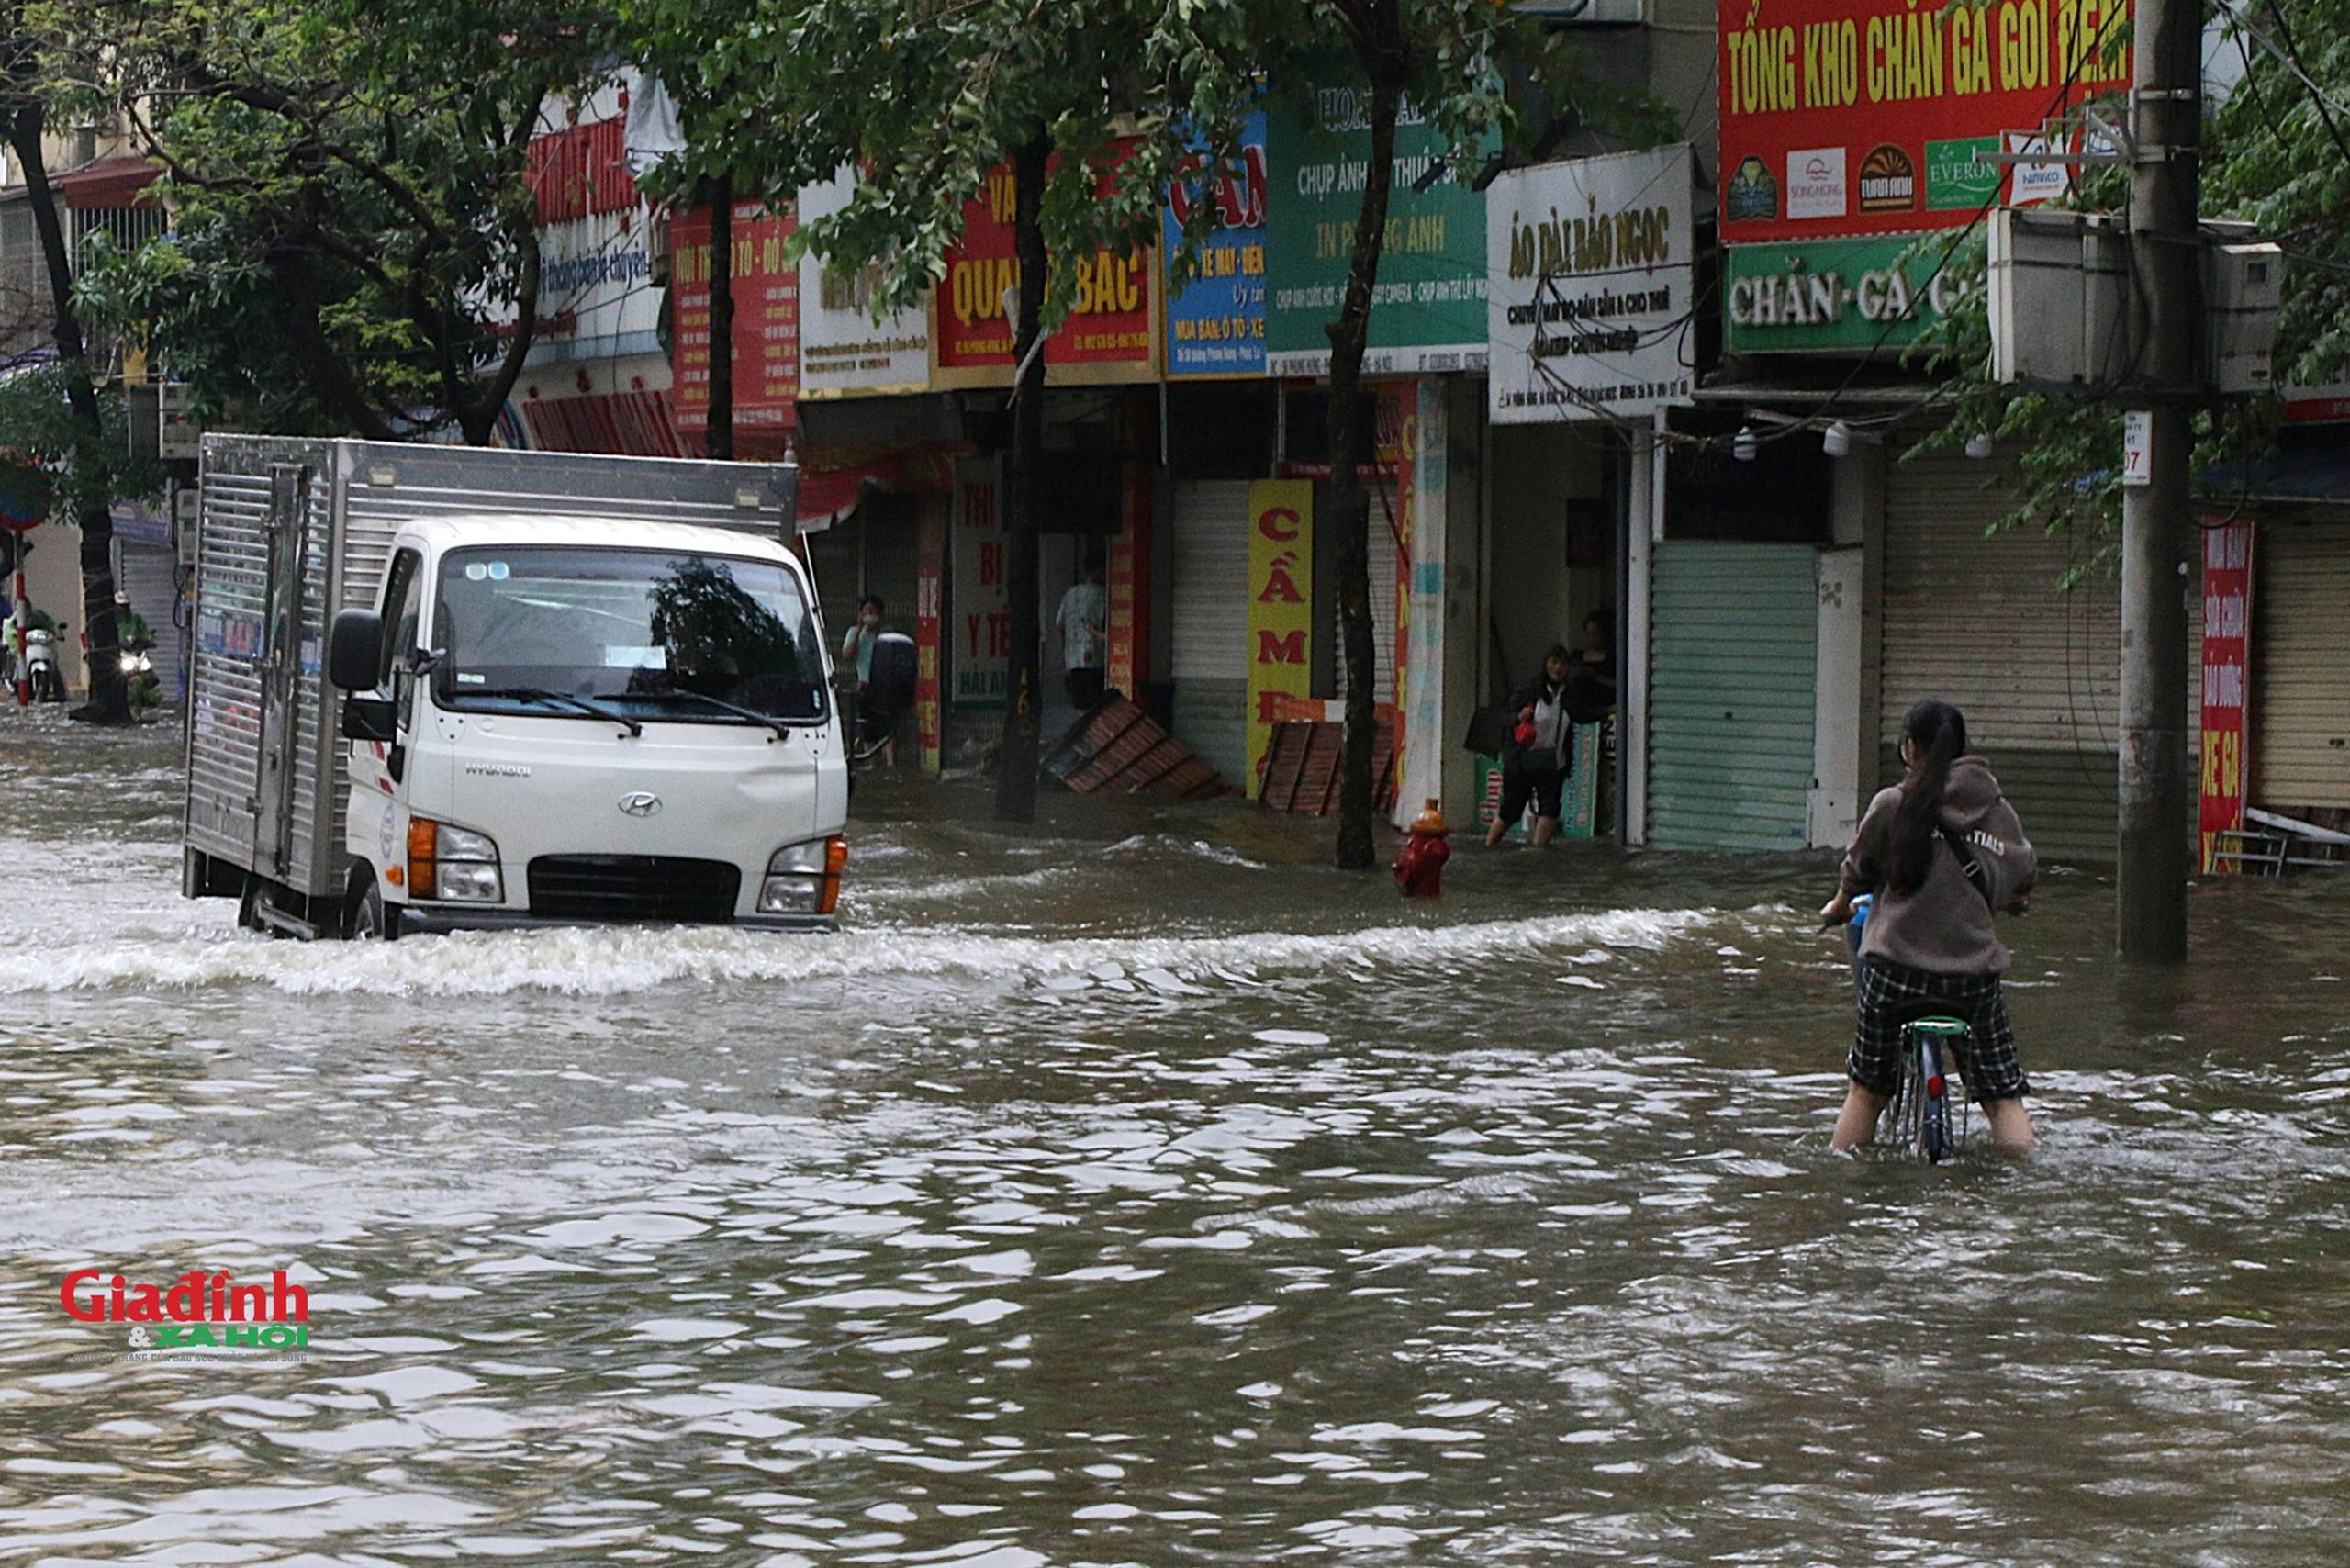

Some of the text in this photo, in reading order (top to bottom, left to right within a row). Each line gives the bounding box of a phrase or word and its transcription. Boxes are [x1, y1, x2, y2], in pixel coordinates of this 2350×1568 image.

[1727, 0, 1797, 115] TỔNG
[1804, 17, 1859, 109] KHO
[1953, 6, 1992, 96] GA
[1337, 151, 1368, 192] ẢNH
[1930, 161, 1998, 183] EVERON
[1315, 221, 1336, 259] IN
[1407, 203, 1444, 252] ẢNH
[1729, 255, 1838, 326] CHĂN
[1857, 269, 1913, 320] GA
[465, 762, 532, 778] HYUNDAI
